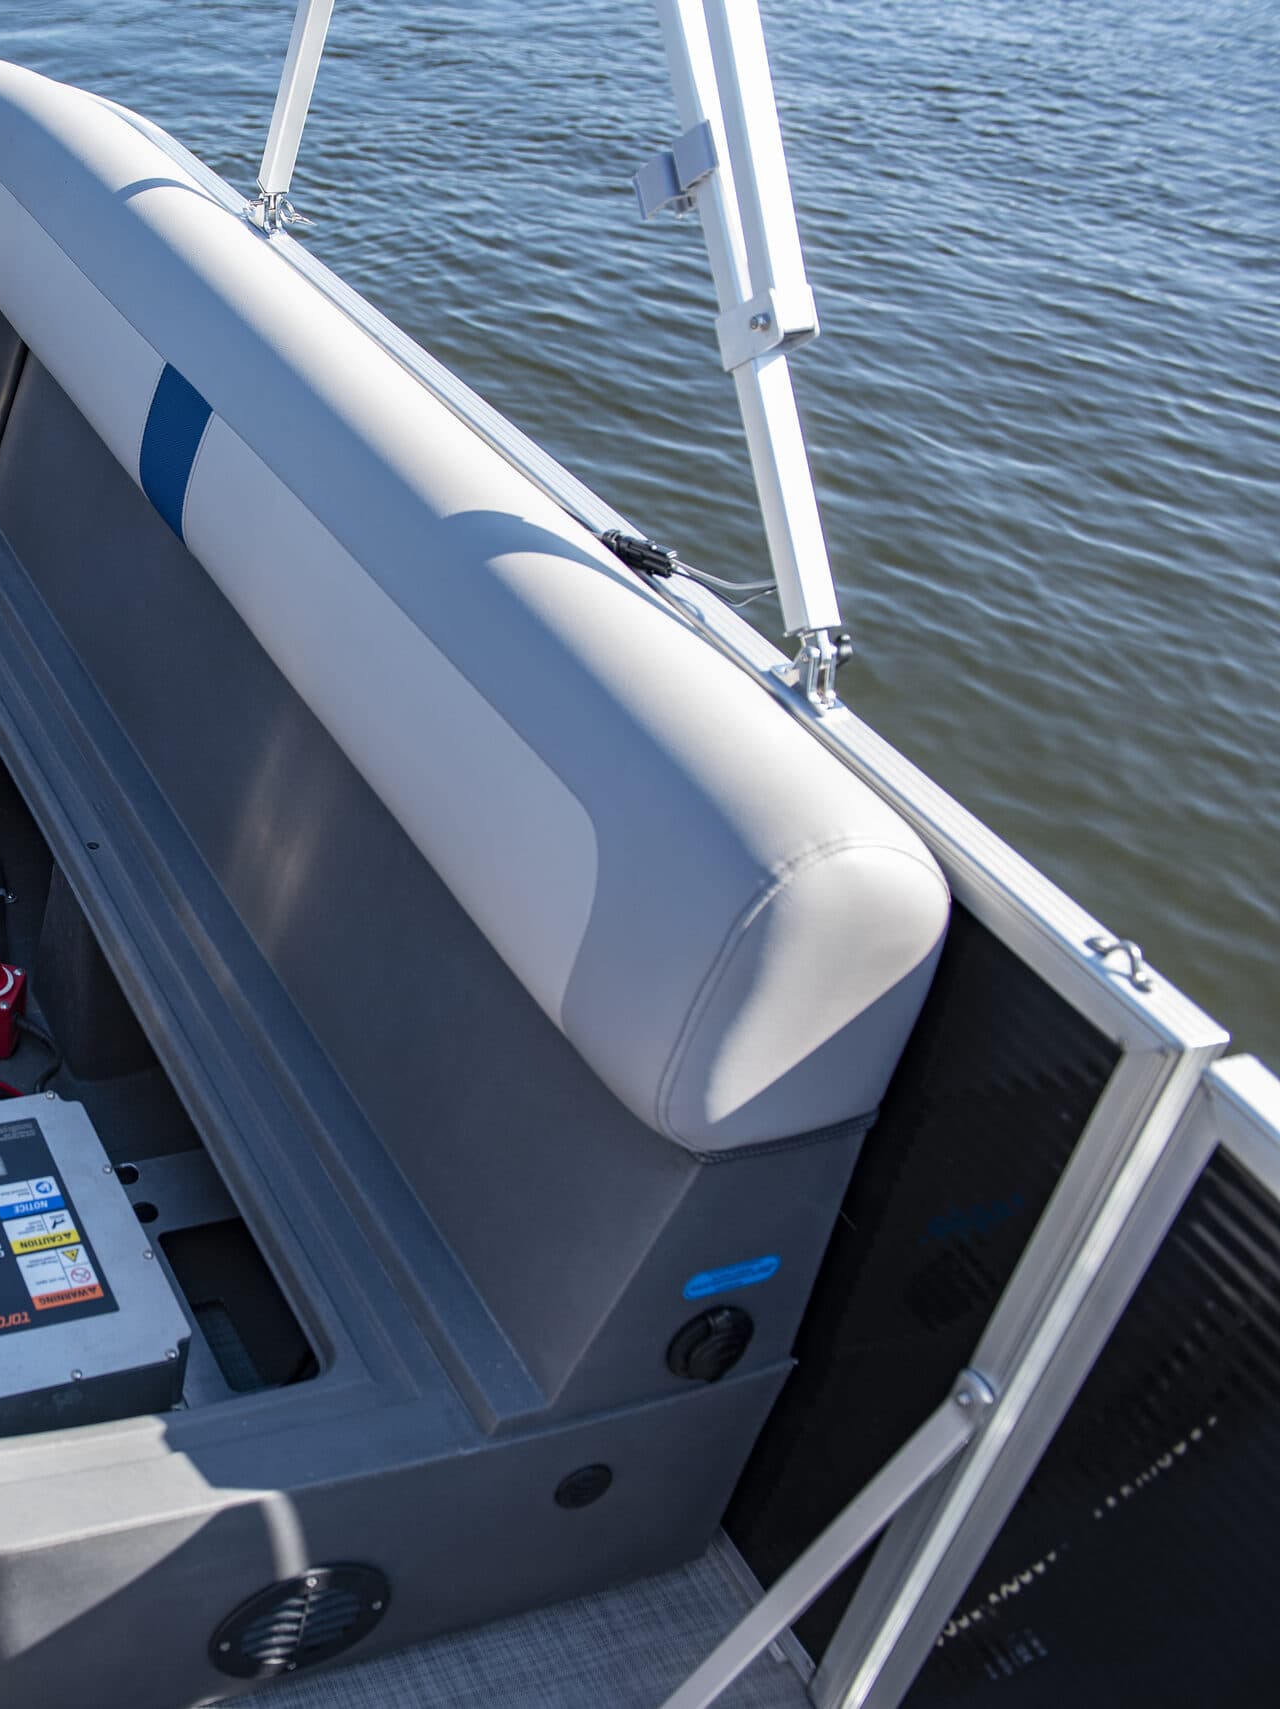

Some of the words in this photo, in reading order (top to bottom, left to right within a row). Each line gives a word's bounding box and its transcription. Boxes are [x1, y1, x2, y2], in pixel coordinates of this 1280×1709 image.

[14, 1200, 48, 1213] NOTICE
[20, 1234, 62, 1248] CAUTION
[39, 1289, 88, 1304] WARNING
